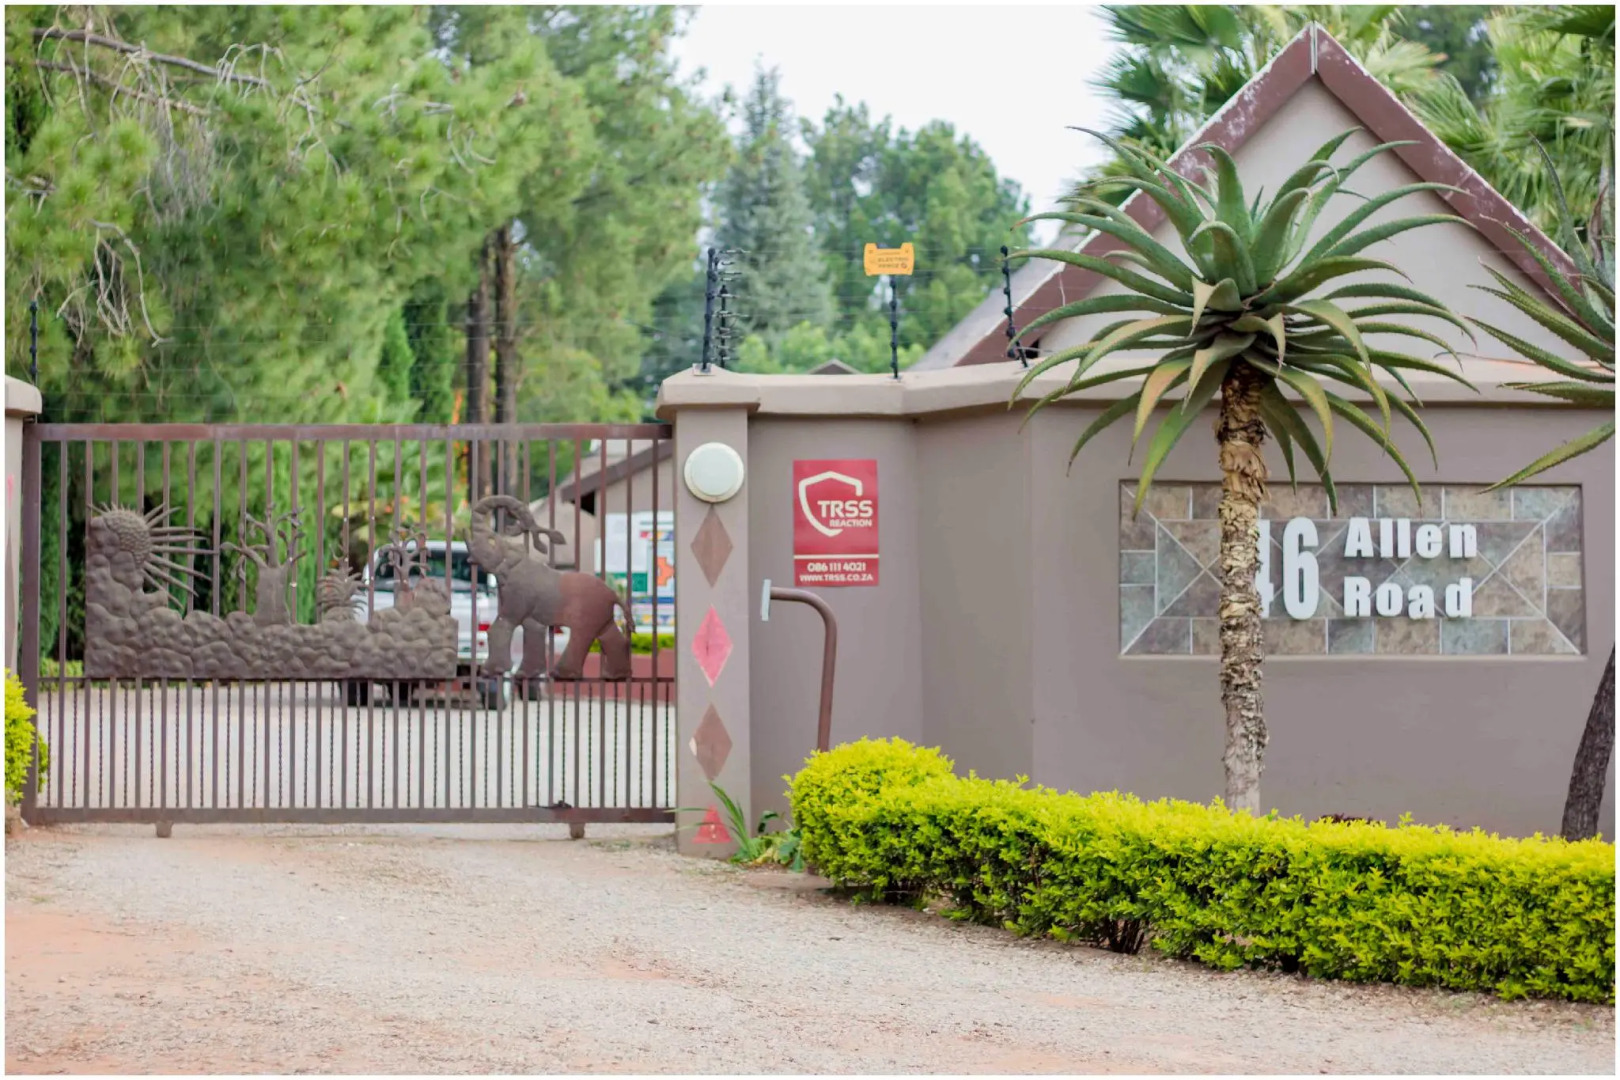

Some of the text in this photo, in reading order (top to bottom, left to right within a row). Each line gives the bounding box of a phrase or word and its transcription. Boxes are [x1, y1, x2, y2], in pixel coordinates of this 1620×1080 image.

[817, 500, 873, 518] TRSS
[829, 519, 872, 527] REACTION
[1344, 517, 1477, 559] Allen
[807, 562, 866, 572] 086 111 4021
[1344, 576, 1472, 619] Road
